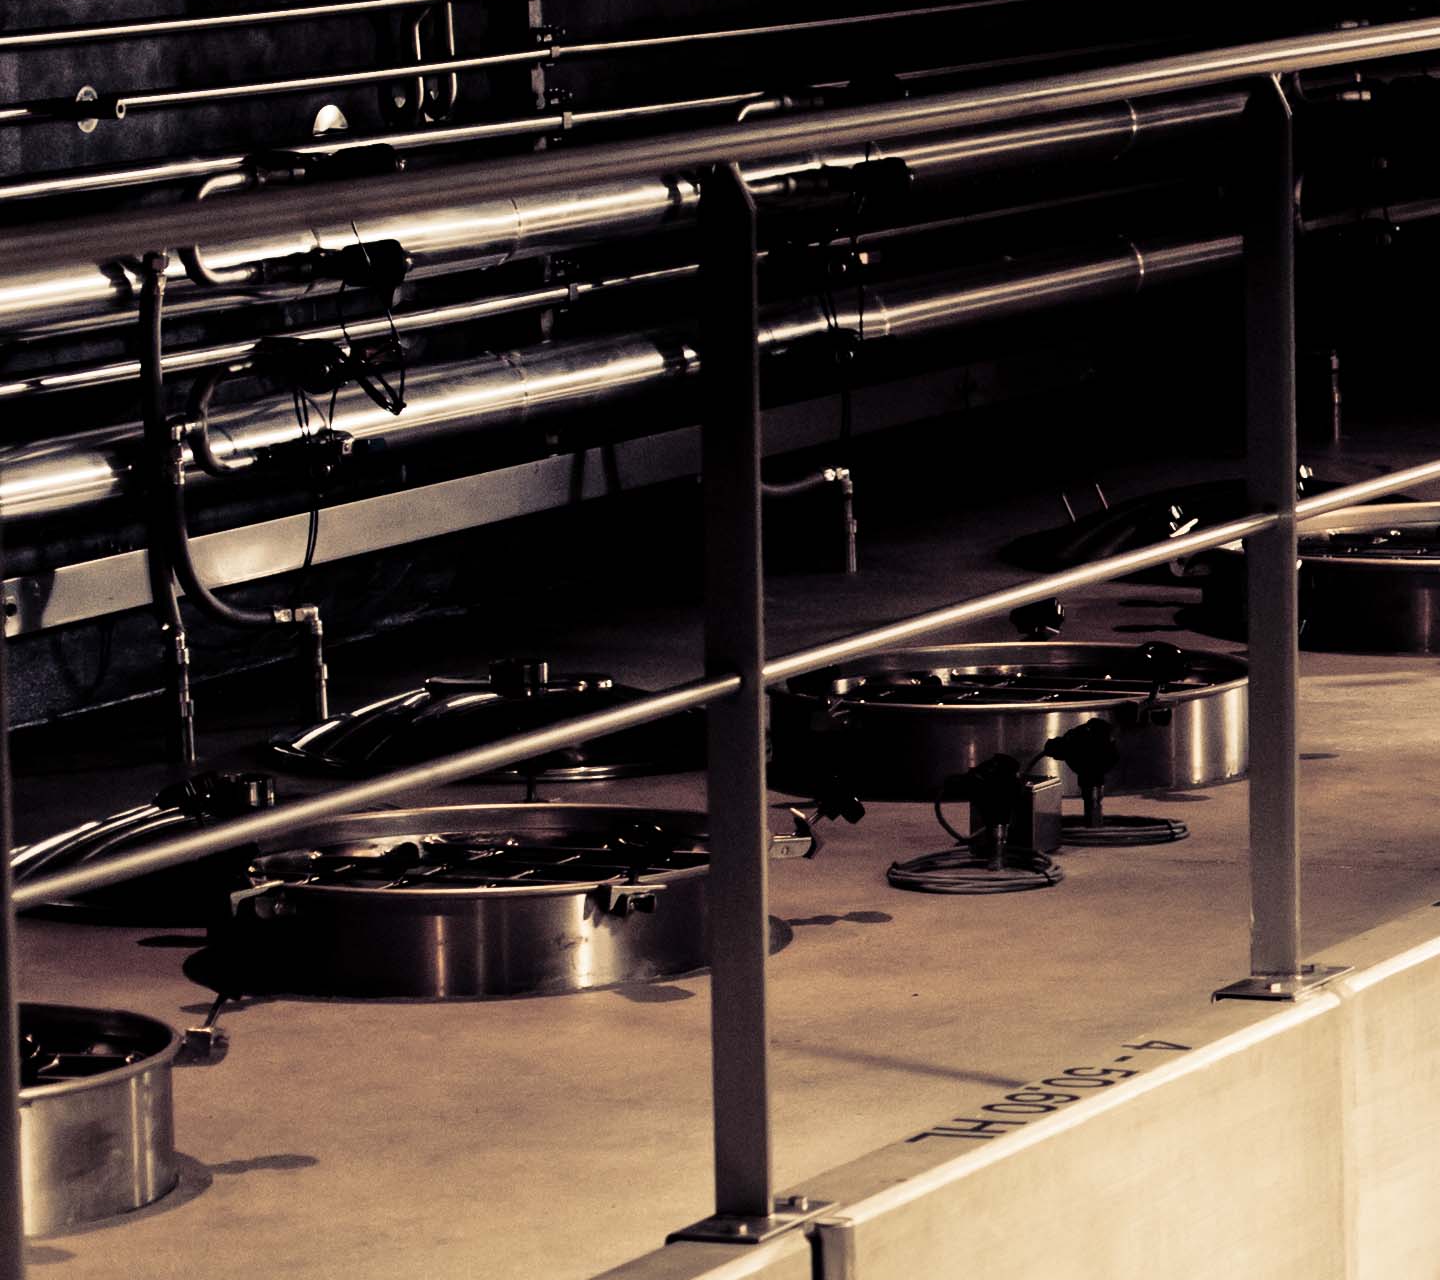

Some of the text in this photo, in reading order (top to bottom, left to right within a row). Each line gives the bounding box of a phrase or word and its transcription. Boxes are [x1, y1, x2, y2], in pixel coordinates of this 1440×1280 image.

[1120, 1039, 1193, 1051] 4
[980, 1066, 1140, 1114] 50.60
[904, 1117, 1029, 1144] HL
